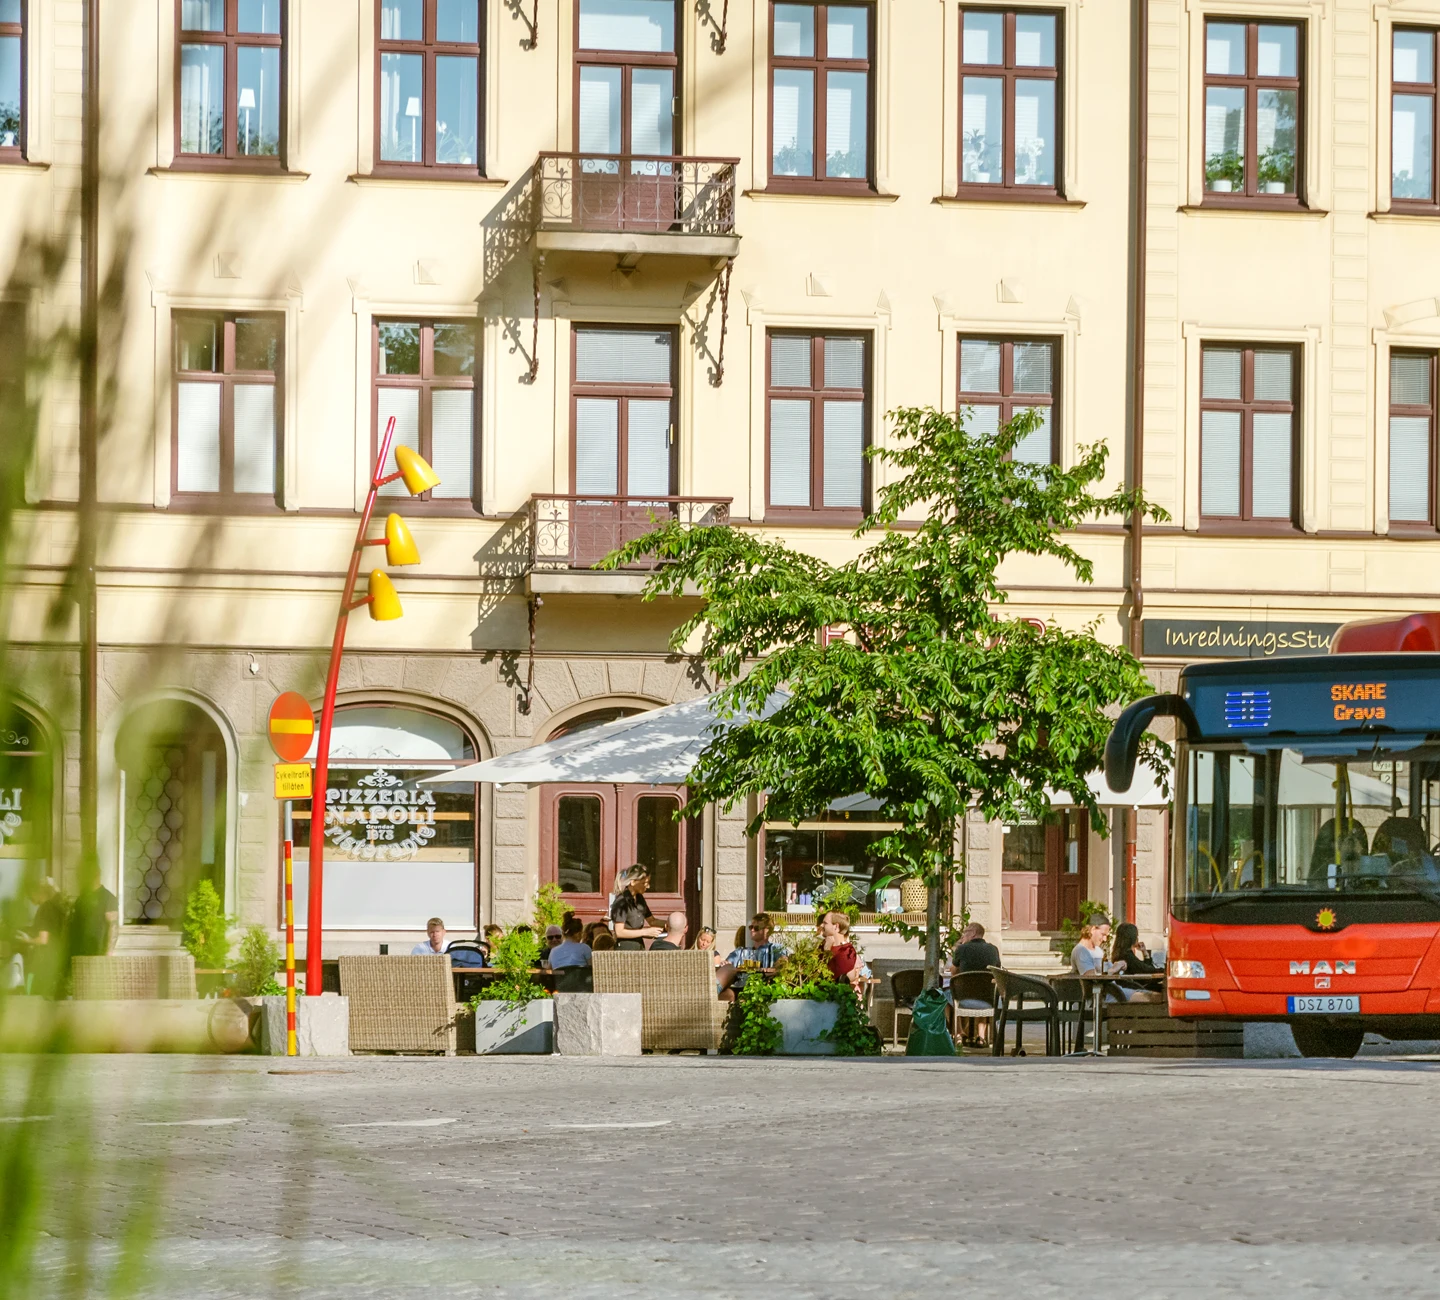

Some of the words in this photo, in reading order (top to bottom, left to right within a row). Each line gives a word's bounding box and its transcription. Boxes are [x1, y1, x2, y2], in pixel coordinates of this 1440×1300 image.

[1333, 704, 1386, 721] Grava
[276, 770, 310, 780] Cykeltrafik
[282, 782, 304, 791] tillåten
[325, 788, 436, 805] PIZZERIA
[324, 805, 436, 825] NAPOLI
[324, 826, 436, 859] ristorante
[1289, 960, 1357, 975] MAN
[1299, 998, 1323, 1011] DSZ
[1327, 998, 1353, 1011] 870
